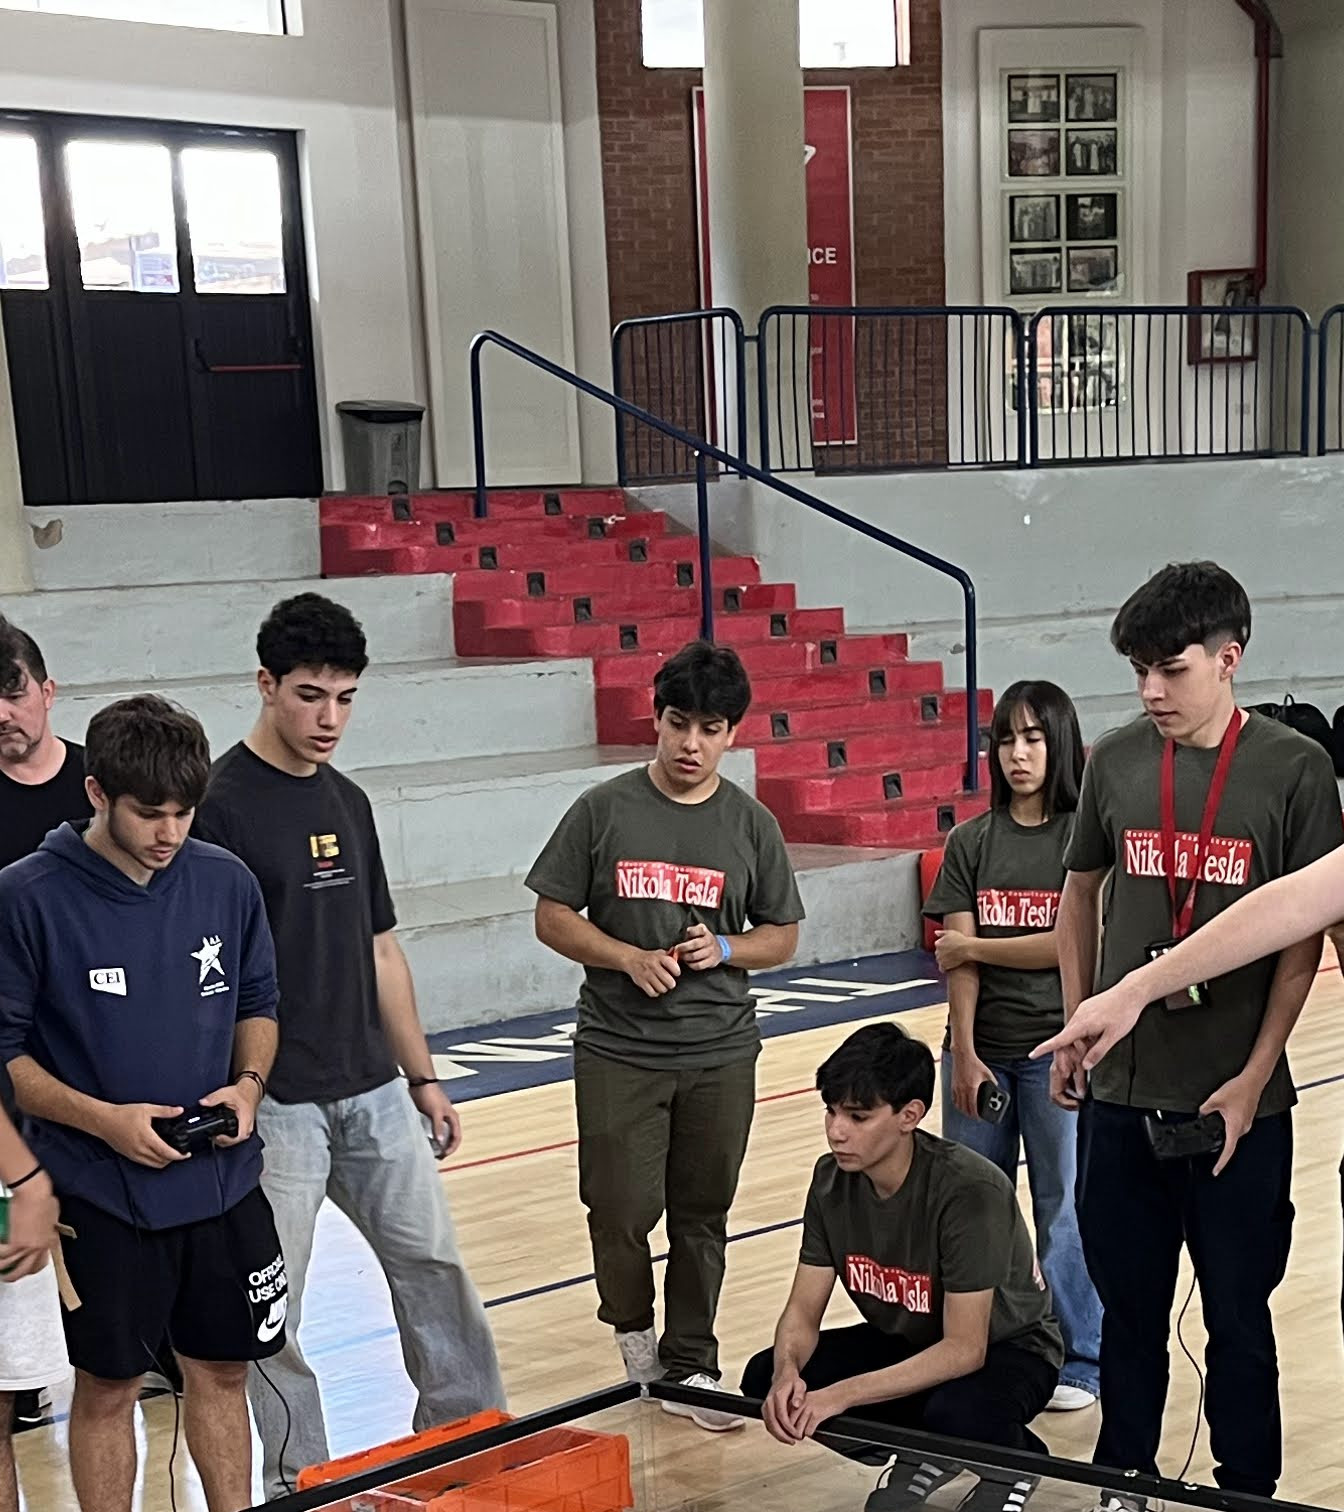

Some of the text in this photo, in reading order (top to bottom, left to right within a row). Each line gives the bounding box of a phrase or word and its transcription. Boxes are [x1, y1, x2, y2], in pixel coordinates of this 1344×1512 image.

[617, 867, 673, 901] Nikola
[676, 872, 719, 909] Tesla
[977, 895, 1016, 927] ikola
[93, 971, 121, 985] CEI
